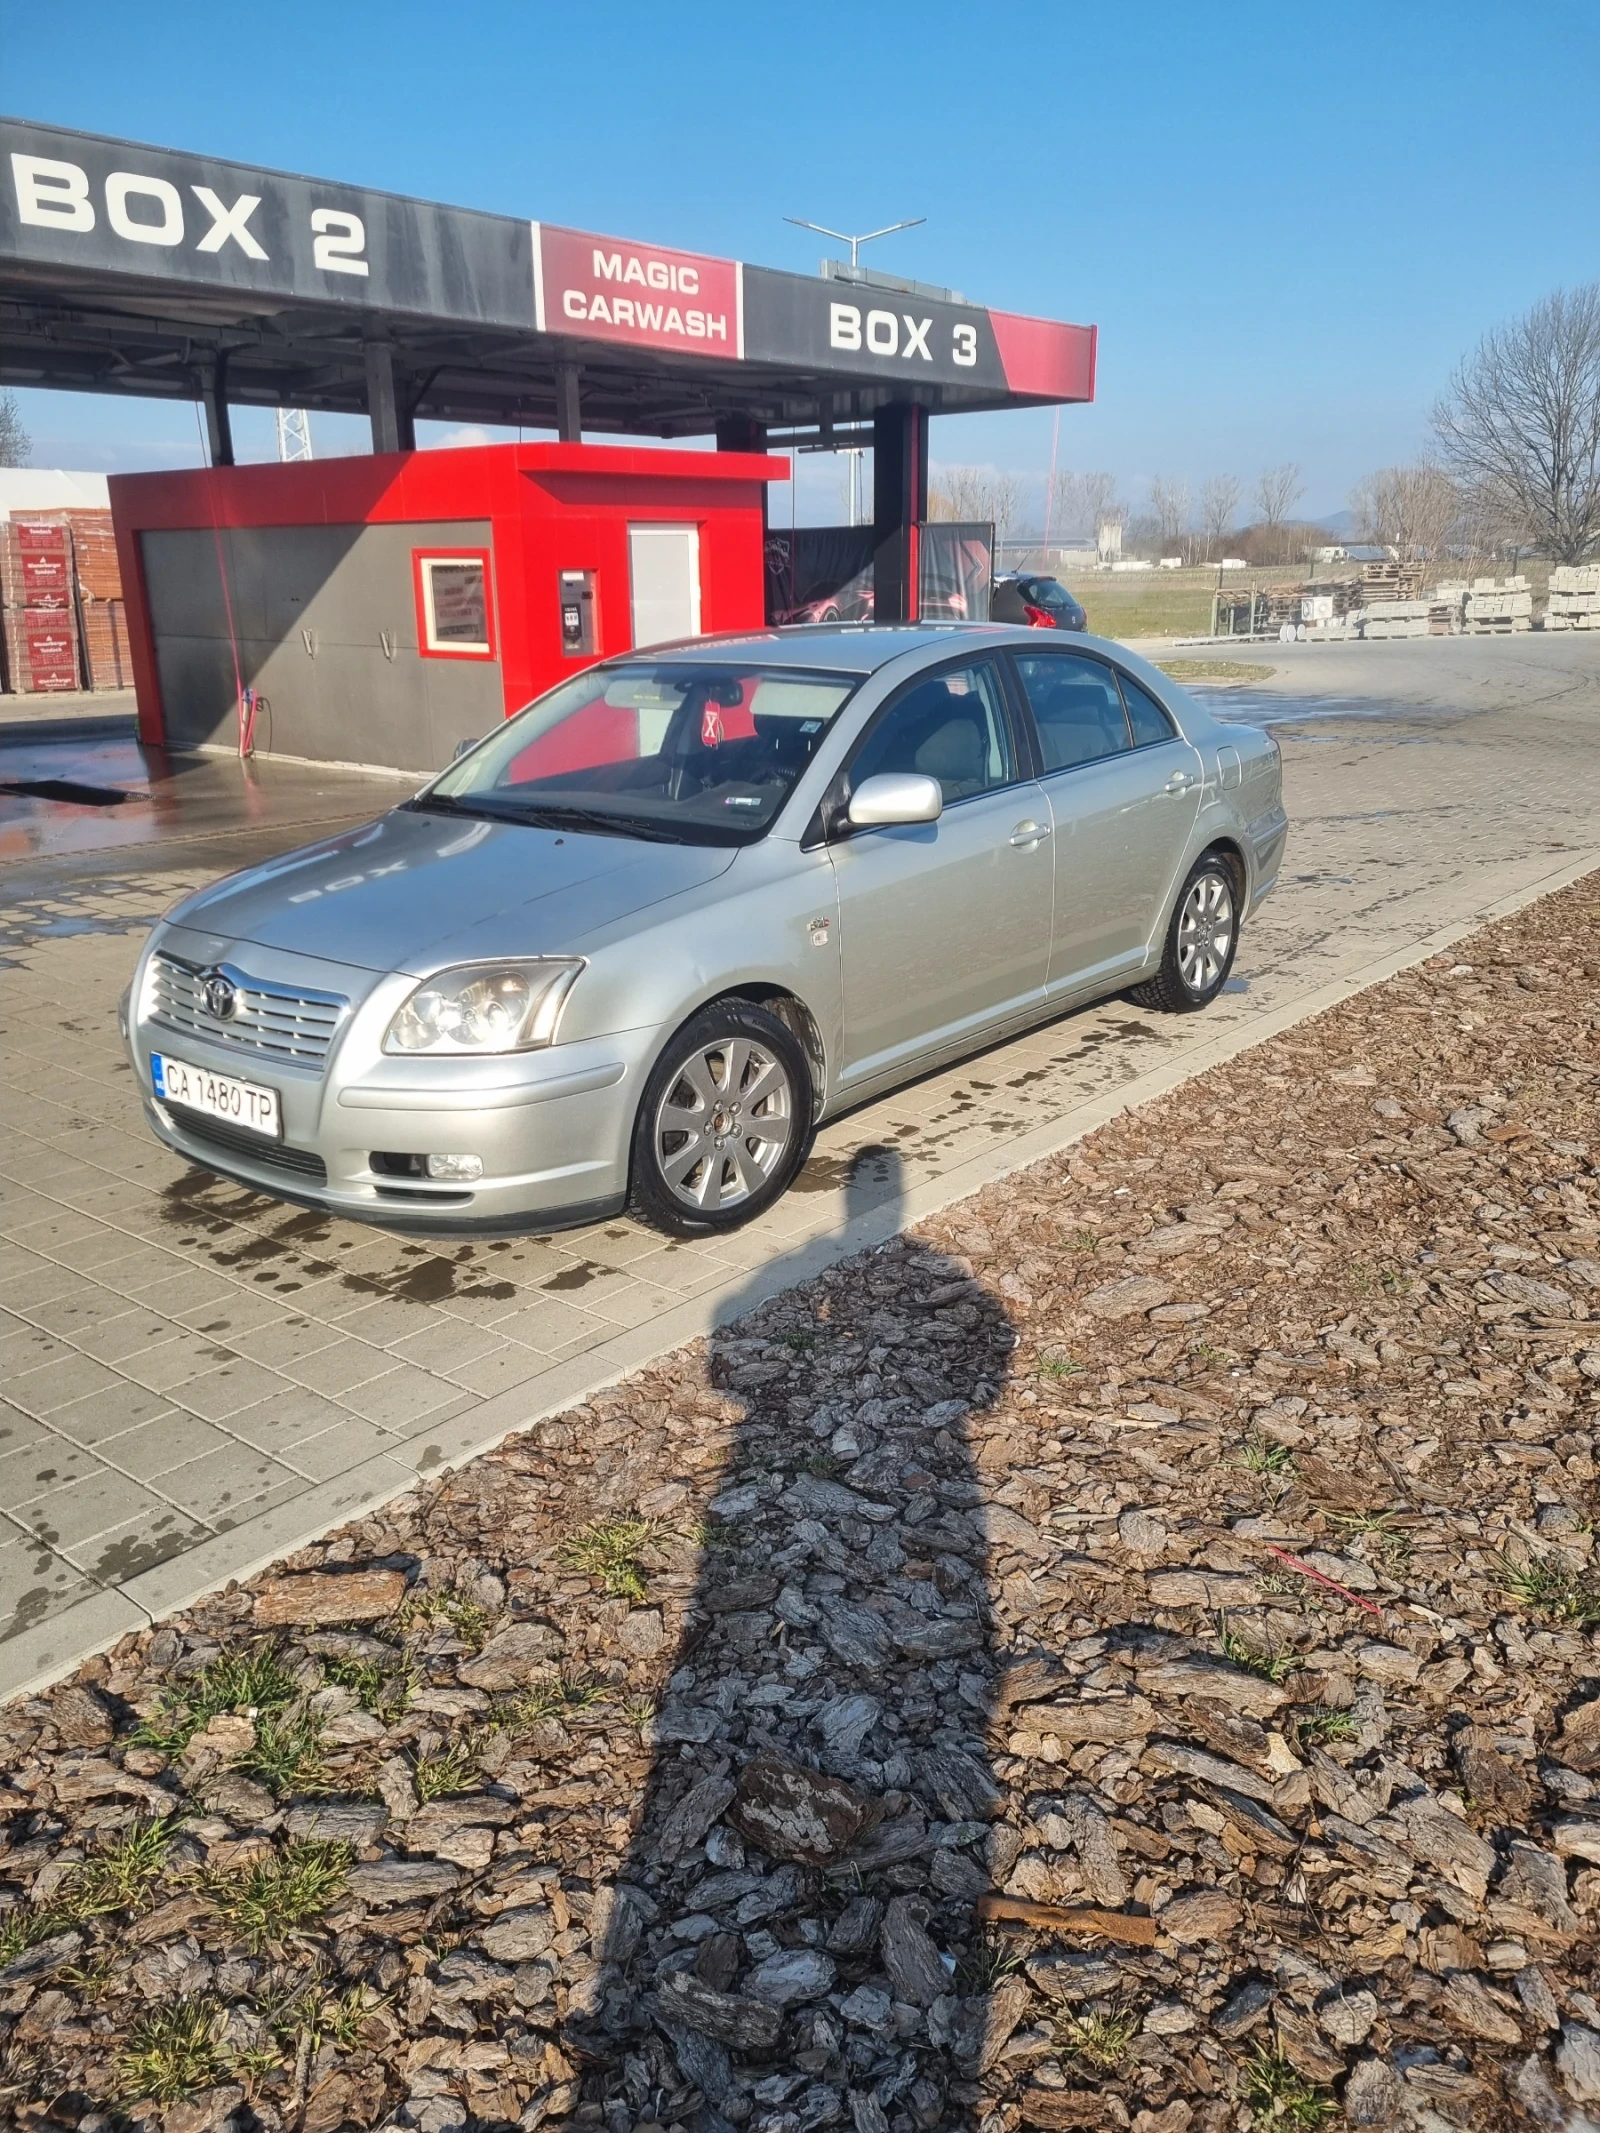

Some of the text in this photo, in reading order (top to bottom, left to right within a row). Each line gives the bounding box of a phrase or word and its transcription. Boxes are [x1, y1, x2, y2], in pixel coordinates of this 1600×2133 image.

[10, 152, 369, 277] BOX 2
[592, 249, 699, 295] MAGIC
[562, 289, 727, 341] CARWASH
[830, 302, 978, 367] BOX 3
[167, 1064, 272, 1126] CA 1480 TP
